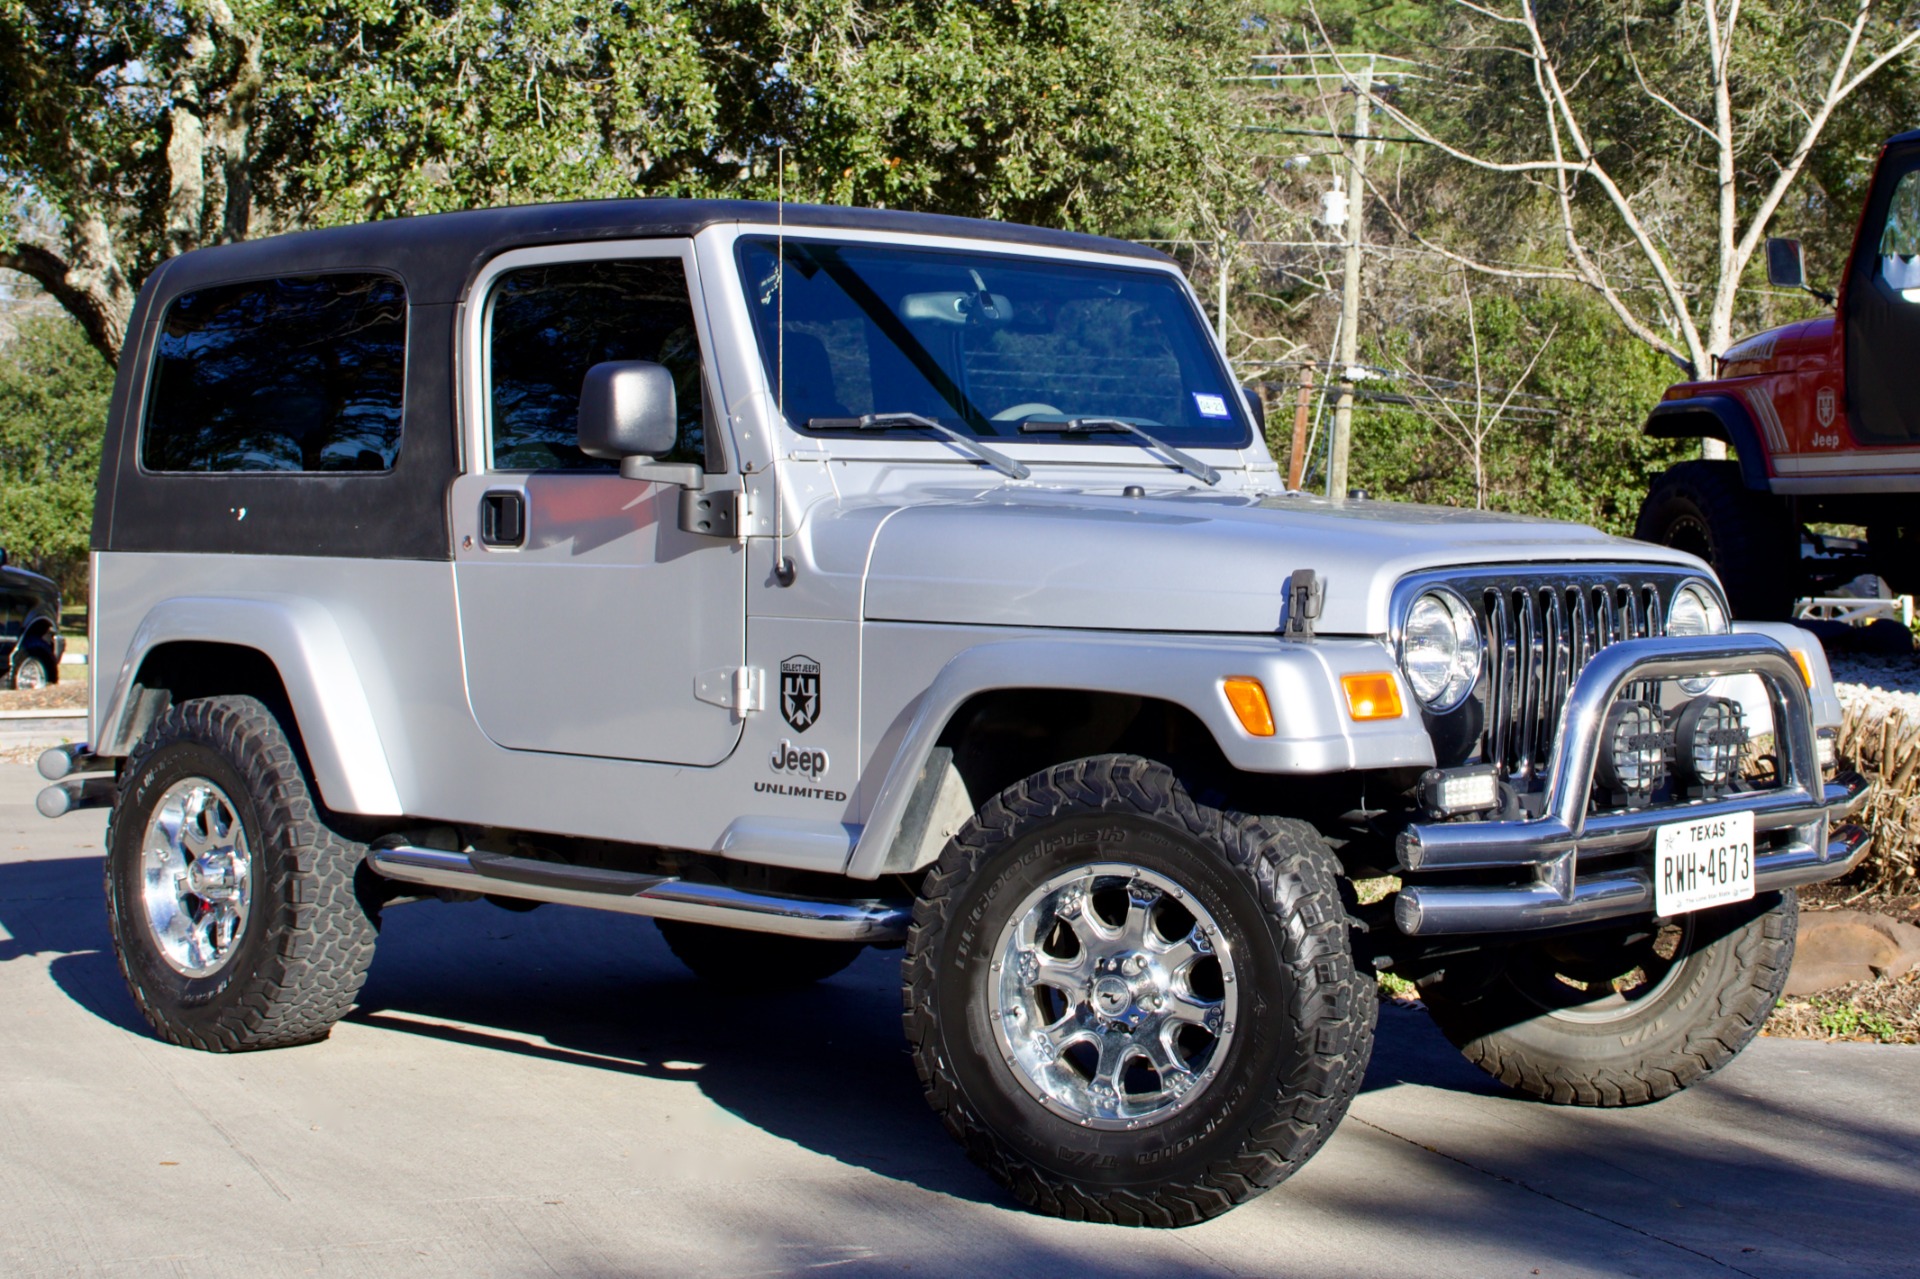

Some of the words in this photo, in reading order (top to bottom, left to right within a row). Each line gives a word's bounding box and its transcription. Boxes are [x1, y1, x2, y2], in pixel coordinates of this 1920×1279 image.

[1811, 431, 1840, 449] Jeep
[782, 663, 802, 672] SELECT
[802, 664, 819, 673] JEEPS
[770, 741, 827, 779] Jeep
[754, 781, 847, 802] UNLIMITED
[1690, 821, 1726, 842] TEXAS
